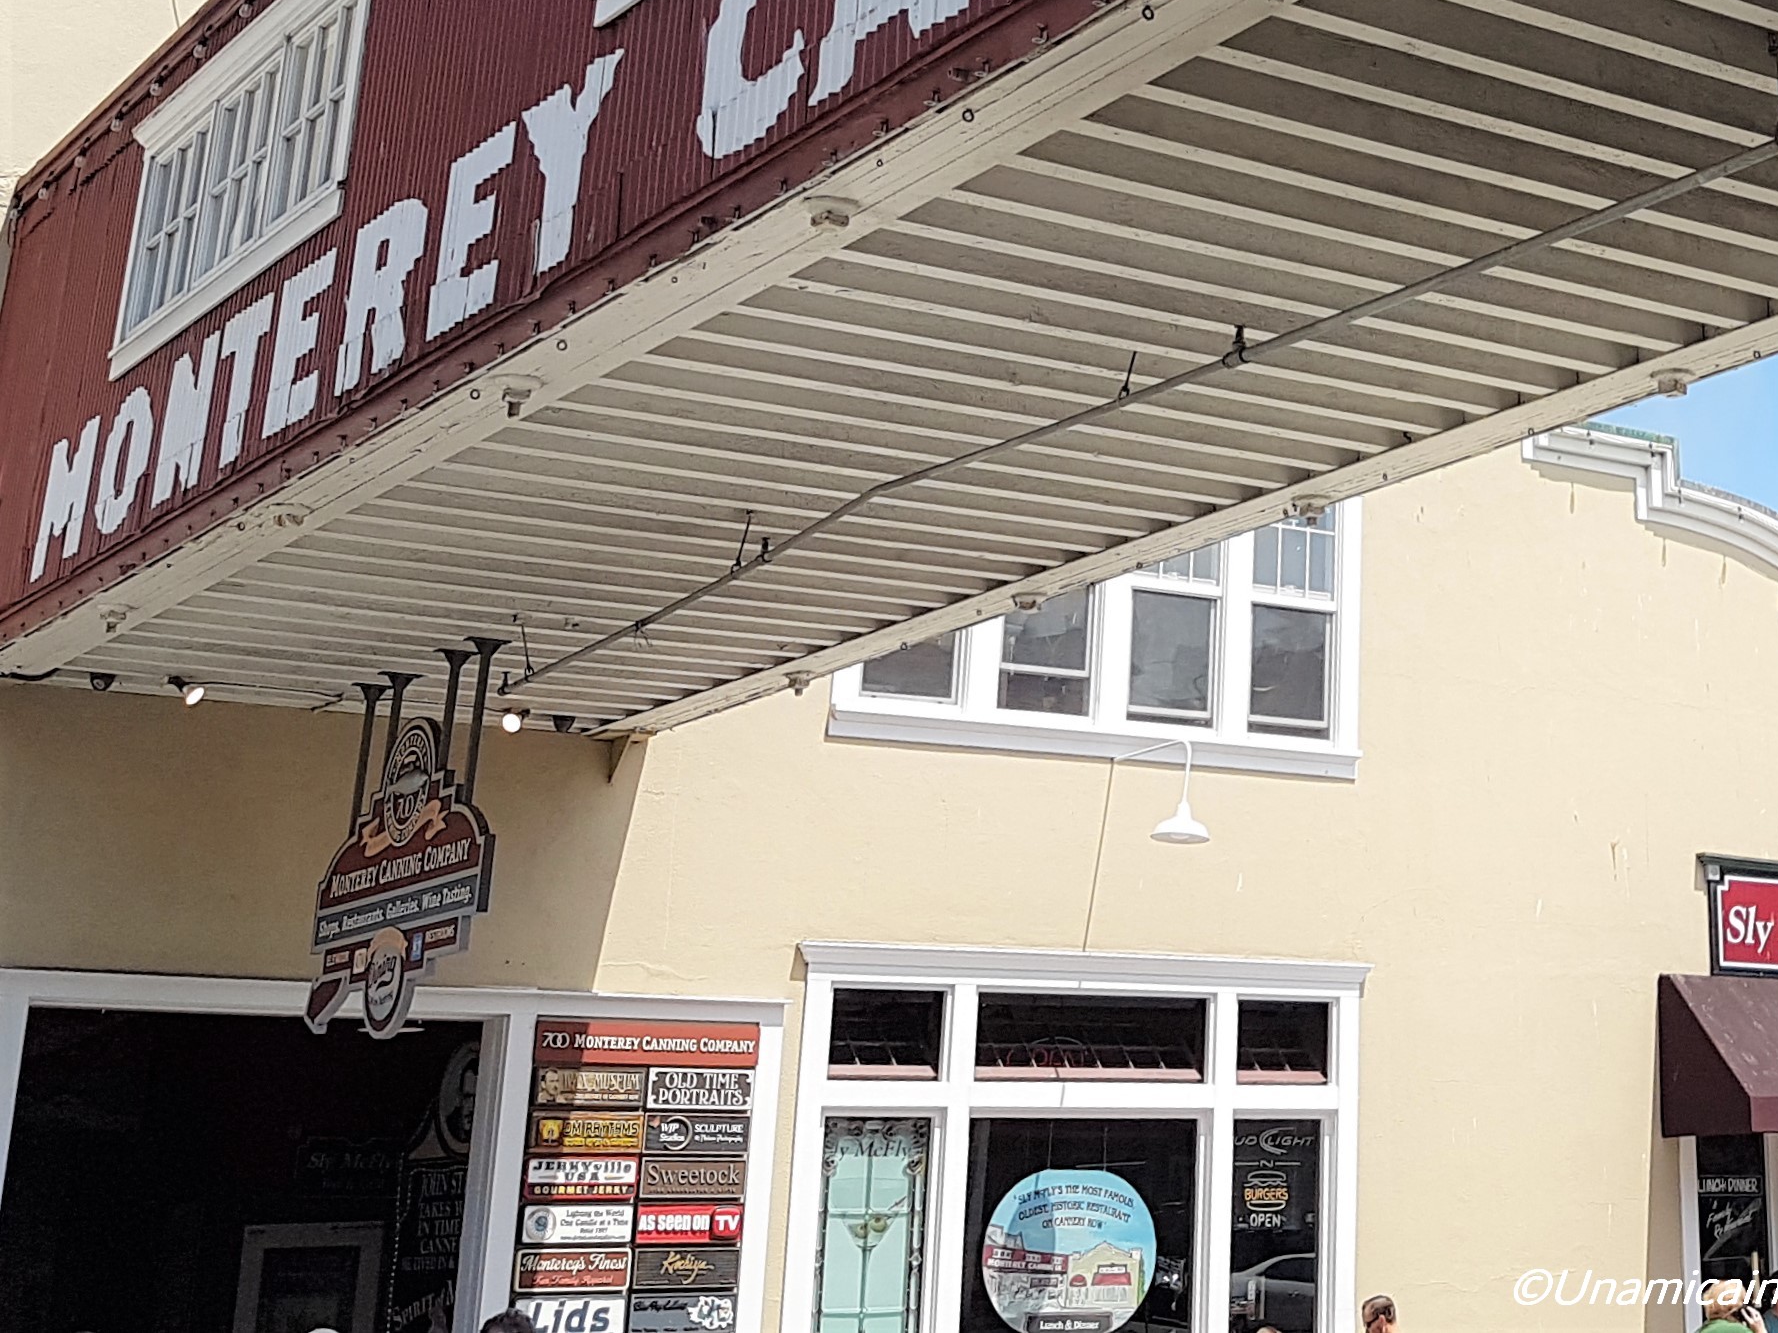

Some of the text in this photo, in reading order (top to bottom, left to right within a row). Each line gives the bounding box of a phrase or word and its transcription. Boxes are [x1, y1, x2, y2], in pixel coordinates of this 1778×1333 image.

[30, 49, 624, 582] MONTEREY
[330, 838, 471, 898] MONTEREY CANNING COMPANY
[1726, 905, 1774, 952] Sly
[541, 1032, 755, 1054] 700 MONTEREY CANNING COMPANY
[665, 1073, 739, 1090] OLD TIME
[658, 1089, 743, 1106] PORTRAITS
[694, 1123, 744, 1134] SCULPTURE
[1234, 1135, 1258, 1146] UD
[532, 1159, 632, 1172] JERKYville
[564, 1171, 600, 1182] USA
[533, 1185, 629, 1195] GOURMET JERKY
[1244, 1187, 1289, 1201] BURGERS
[715, 1215, 739, 1232] TV
[1249, 1213, 1282, 1227] OPEN
[1065, 1319, 1073, 1330] &
